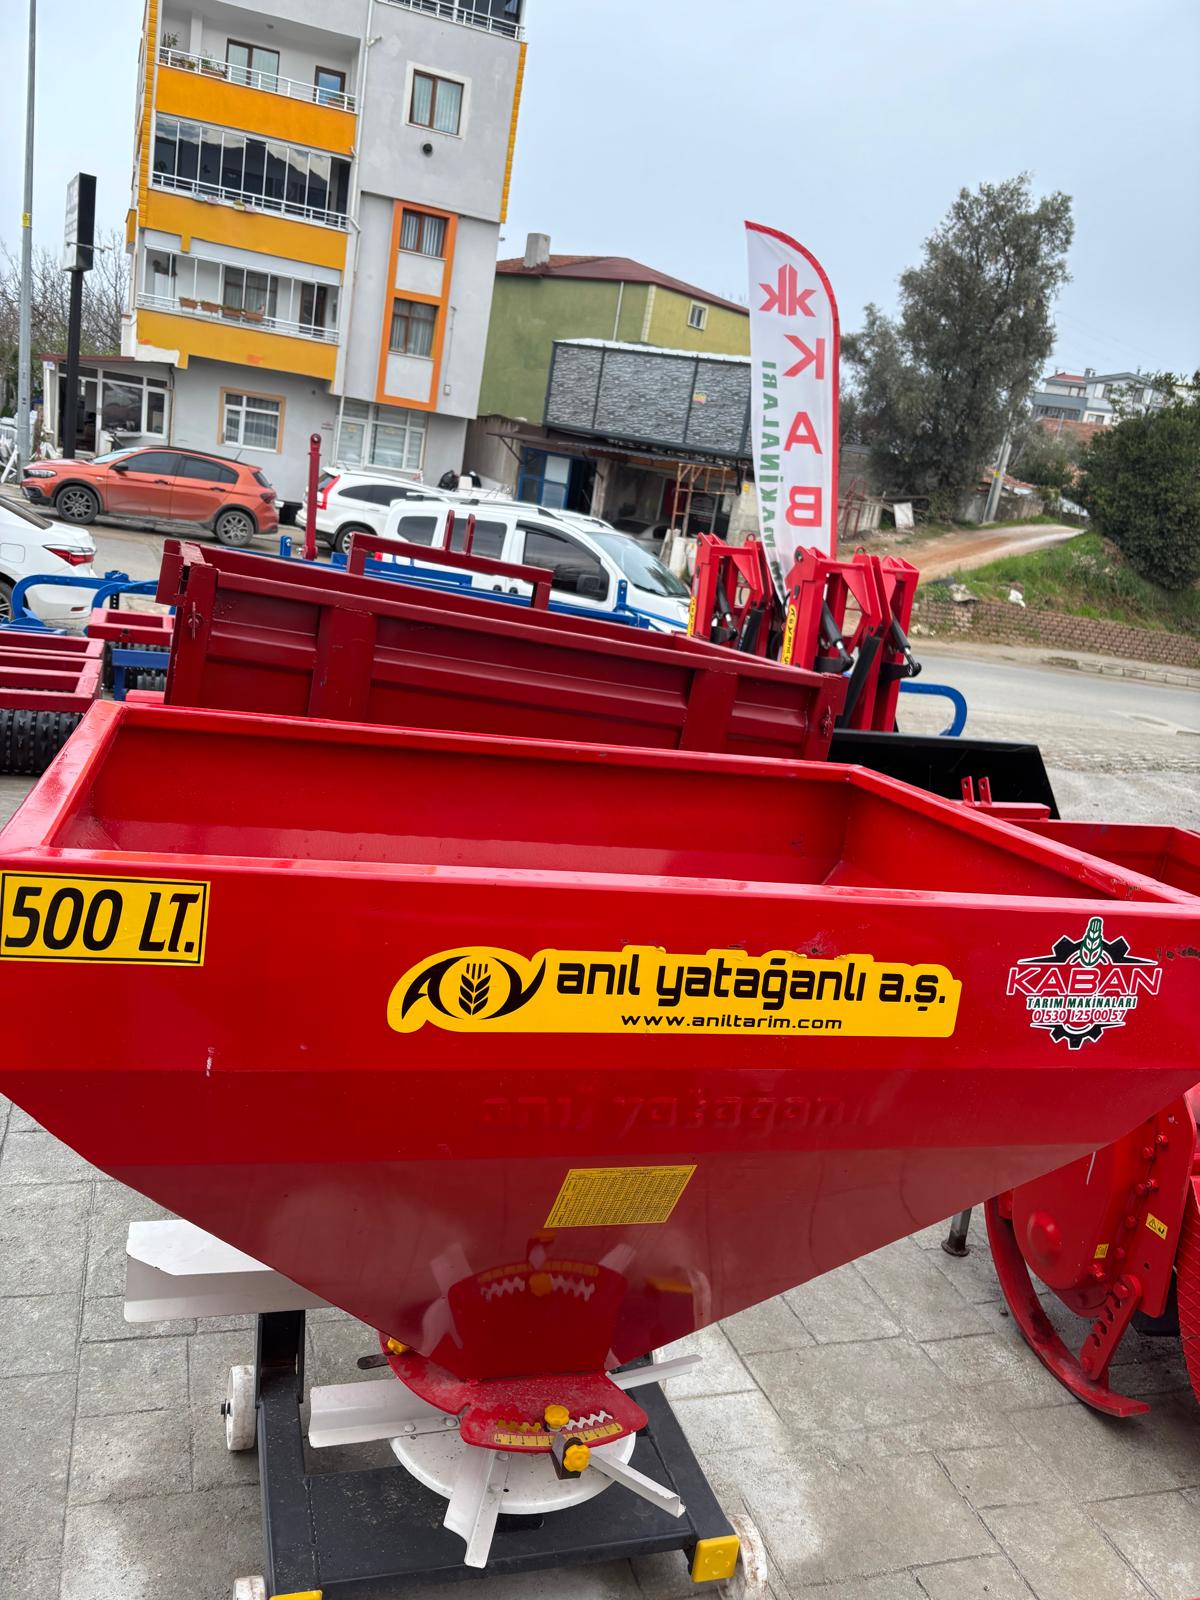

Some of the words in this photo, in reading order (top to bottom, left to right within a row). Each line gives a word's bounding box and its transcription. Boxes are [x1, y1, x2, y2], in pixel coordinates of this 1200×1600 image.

[4, 886, 123, 951] 500
[138, 891, 200, 953] LT.
[556, 953, 641, 996] anıl
[655, 957, 867, 1011] yatağanlı
[878, 971, 946, 1012] a.ş.
[1006, 967, 1163, 995] KABAN
[1027, 997, 1063, 1009] TARIM
[1067, 994, 1137, 1009] MAKİNALARI
[621, 1014, 843, 1030] www.aniltarim.com
